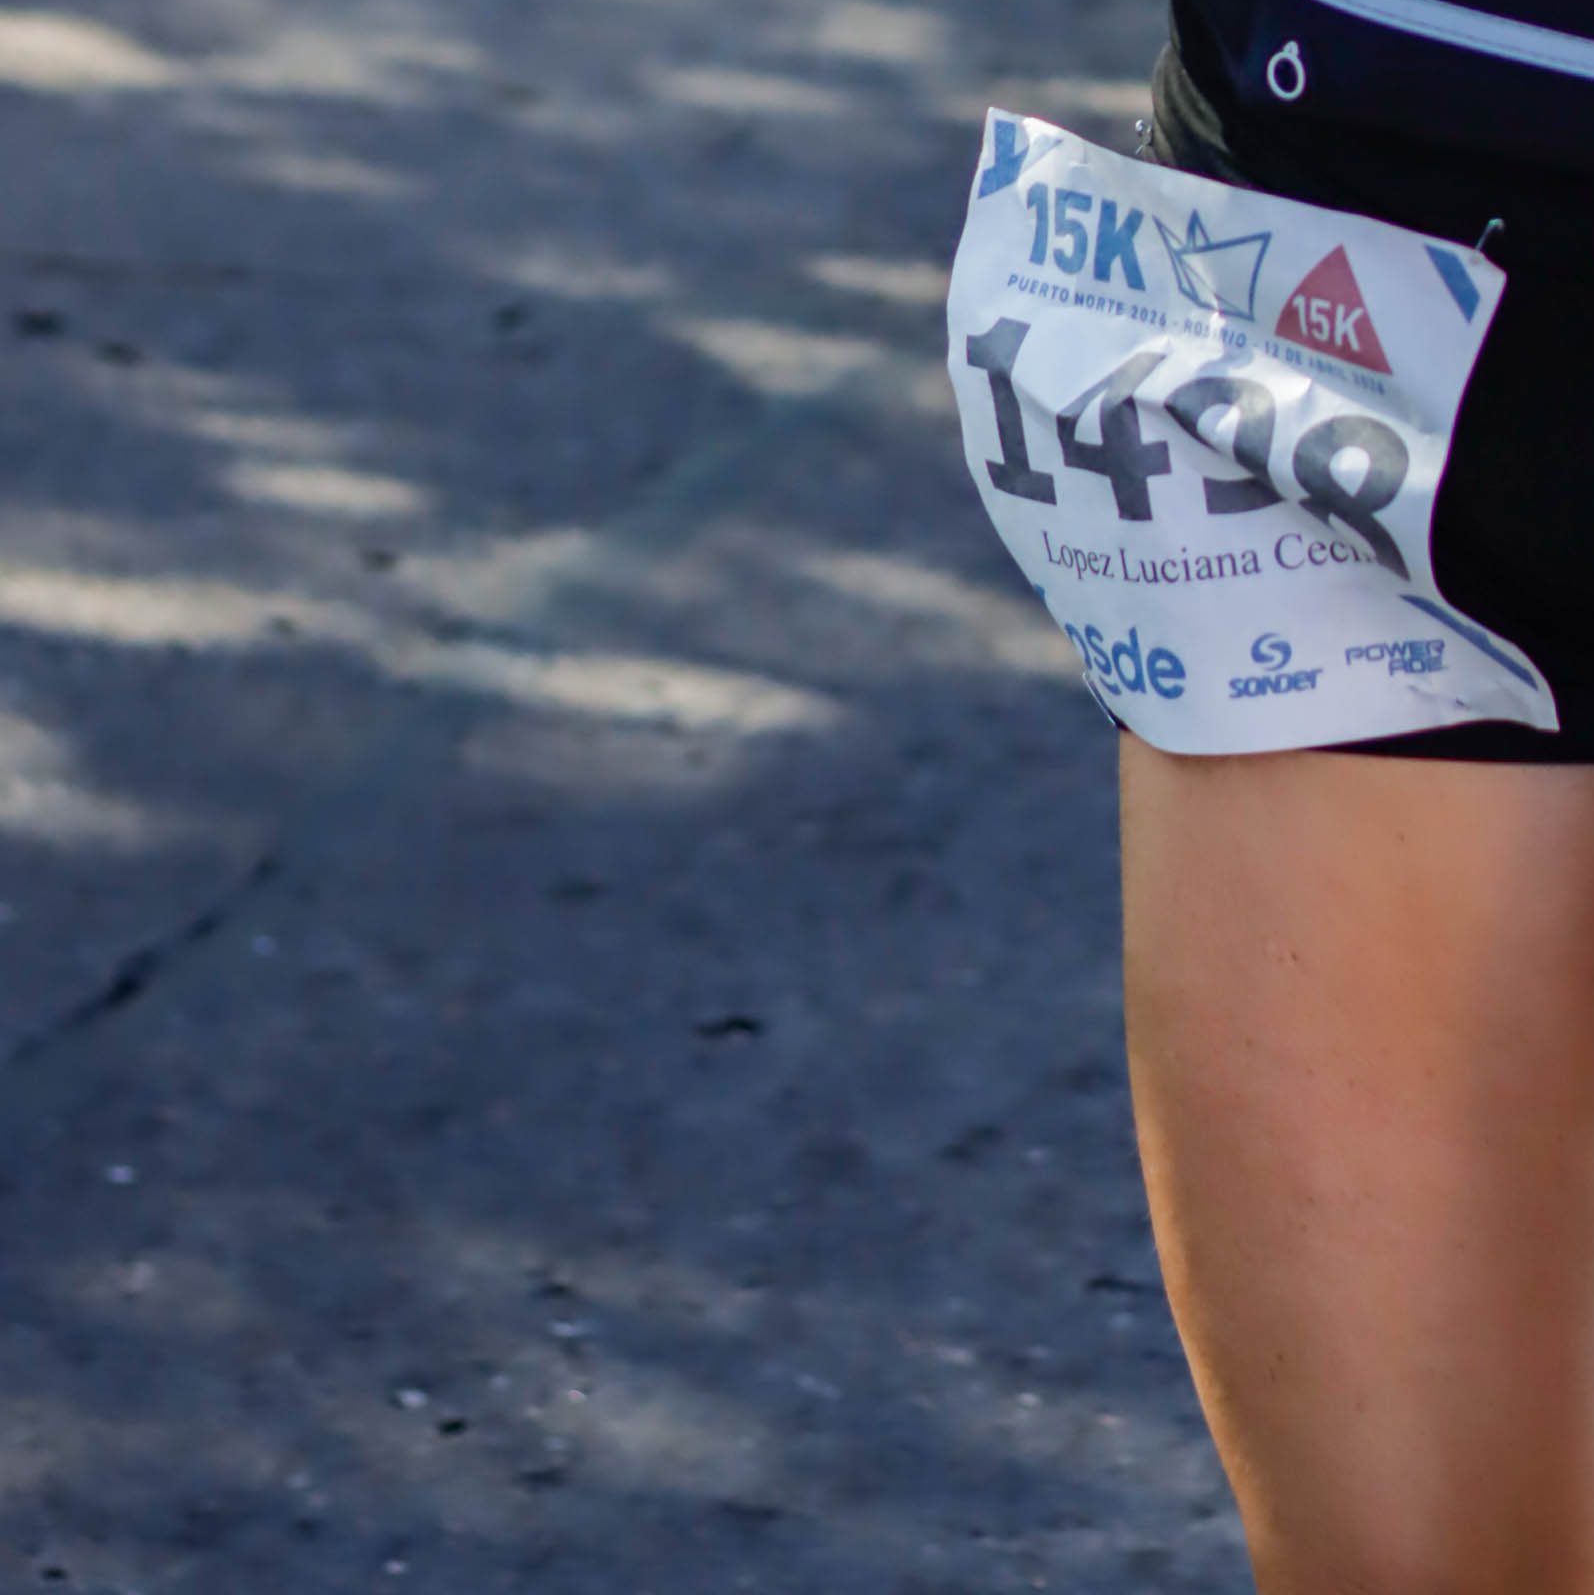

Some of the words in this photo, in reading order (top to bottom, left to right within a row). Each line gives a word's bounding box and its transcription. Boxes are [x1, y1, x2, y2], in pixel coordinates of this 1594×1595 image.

[1027, 182, 1146, 292] 15K
[1007, 274, 1070, 303] PUERTO
[1074, 292, 1125, 315] NORTE
[1290, 292, 1367, 351] 15K
[966, 317, 1411, 582] 1498
[1042, 530, 1115, 580] Lopez
[1118, 547, 1261, 583] Luciana
[1345, 639, 1445, 666] POWER
